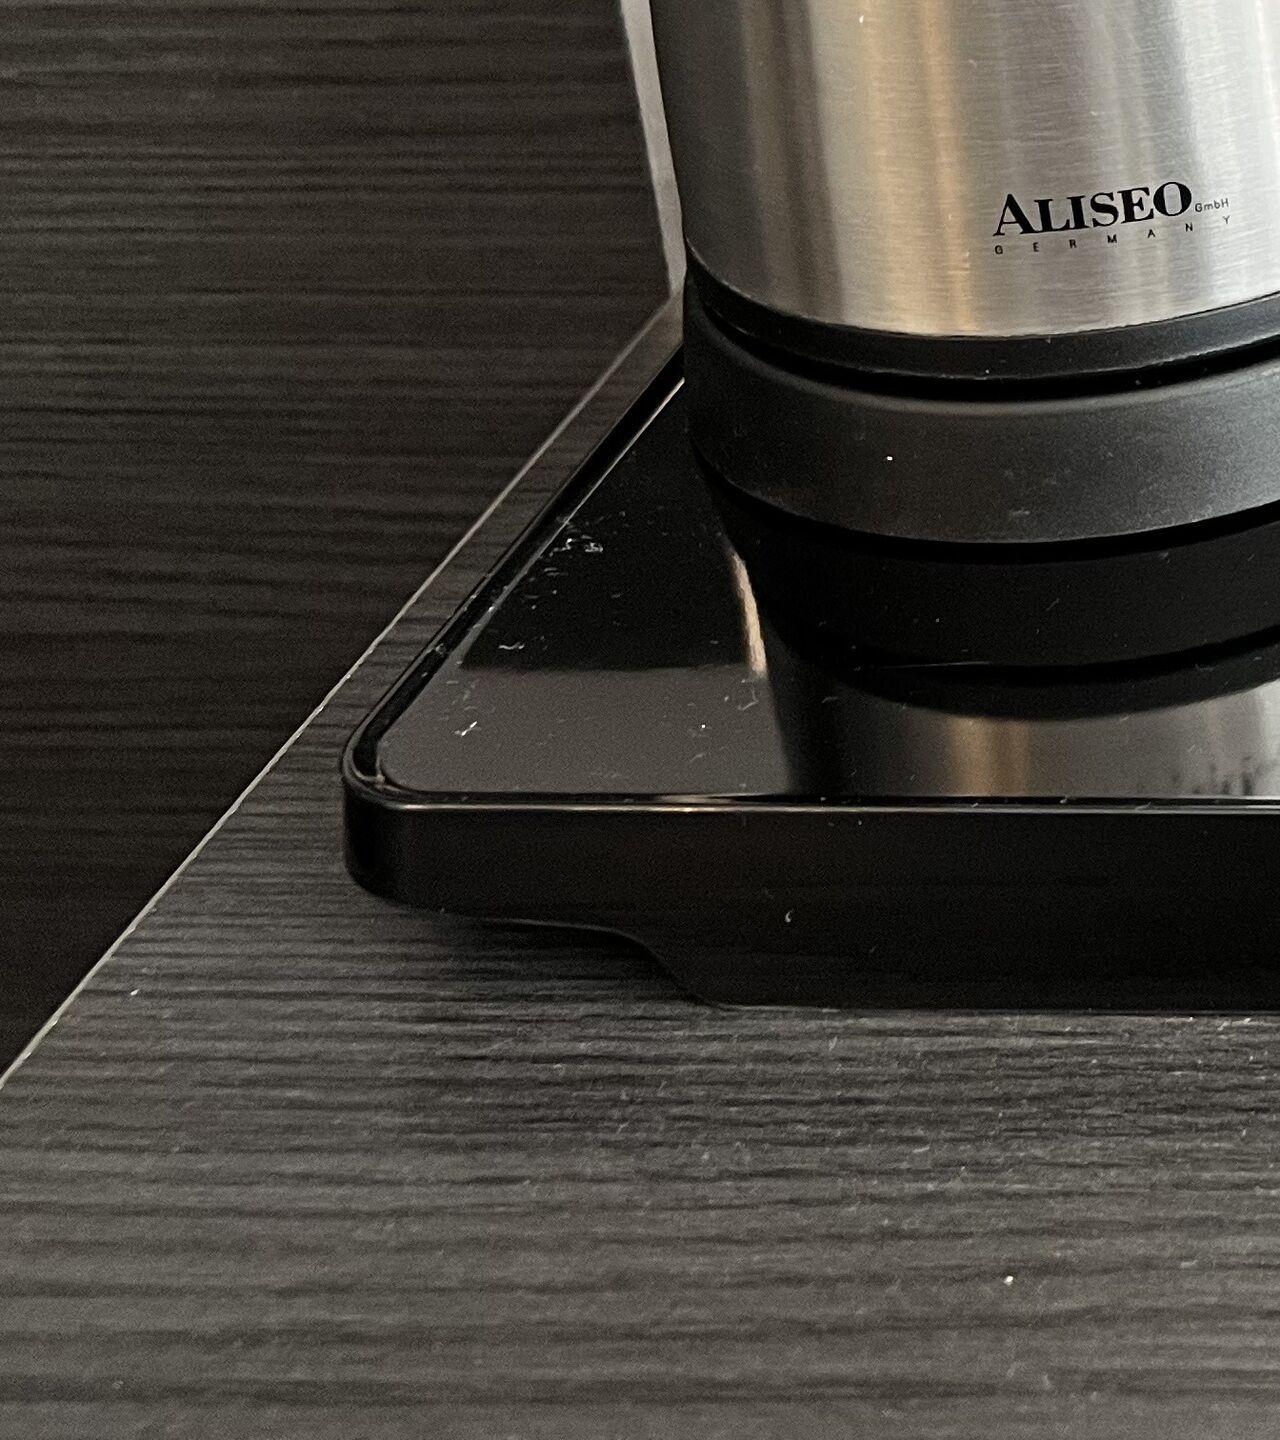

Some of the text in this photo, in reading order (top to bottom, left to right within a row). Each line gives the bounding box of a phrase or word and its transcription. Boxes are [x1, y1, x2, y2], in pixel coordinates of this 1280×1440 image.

[992, 180, 1230, 237] ALISEO GmbH
[993, 214, 1231, 256] GERMANY
